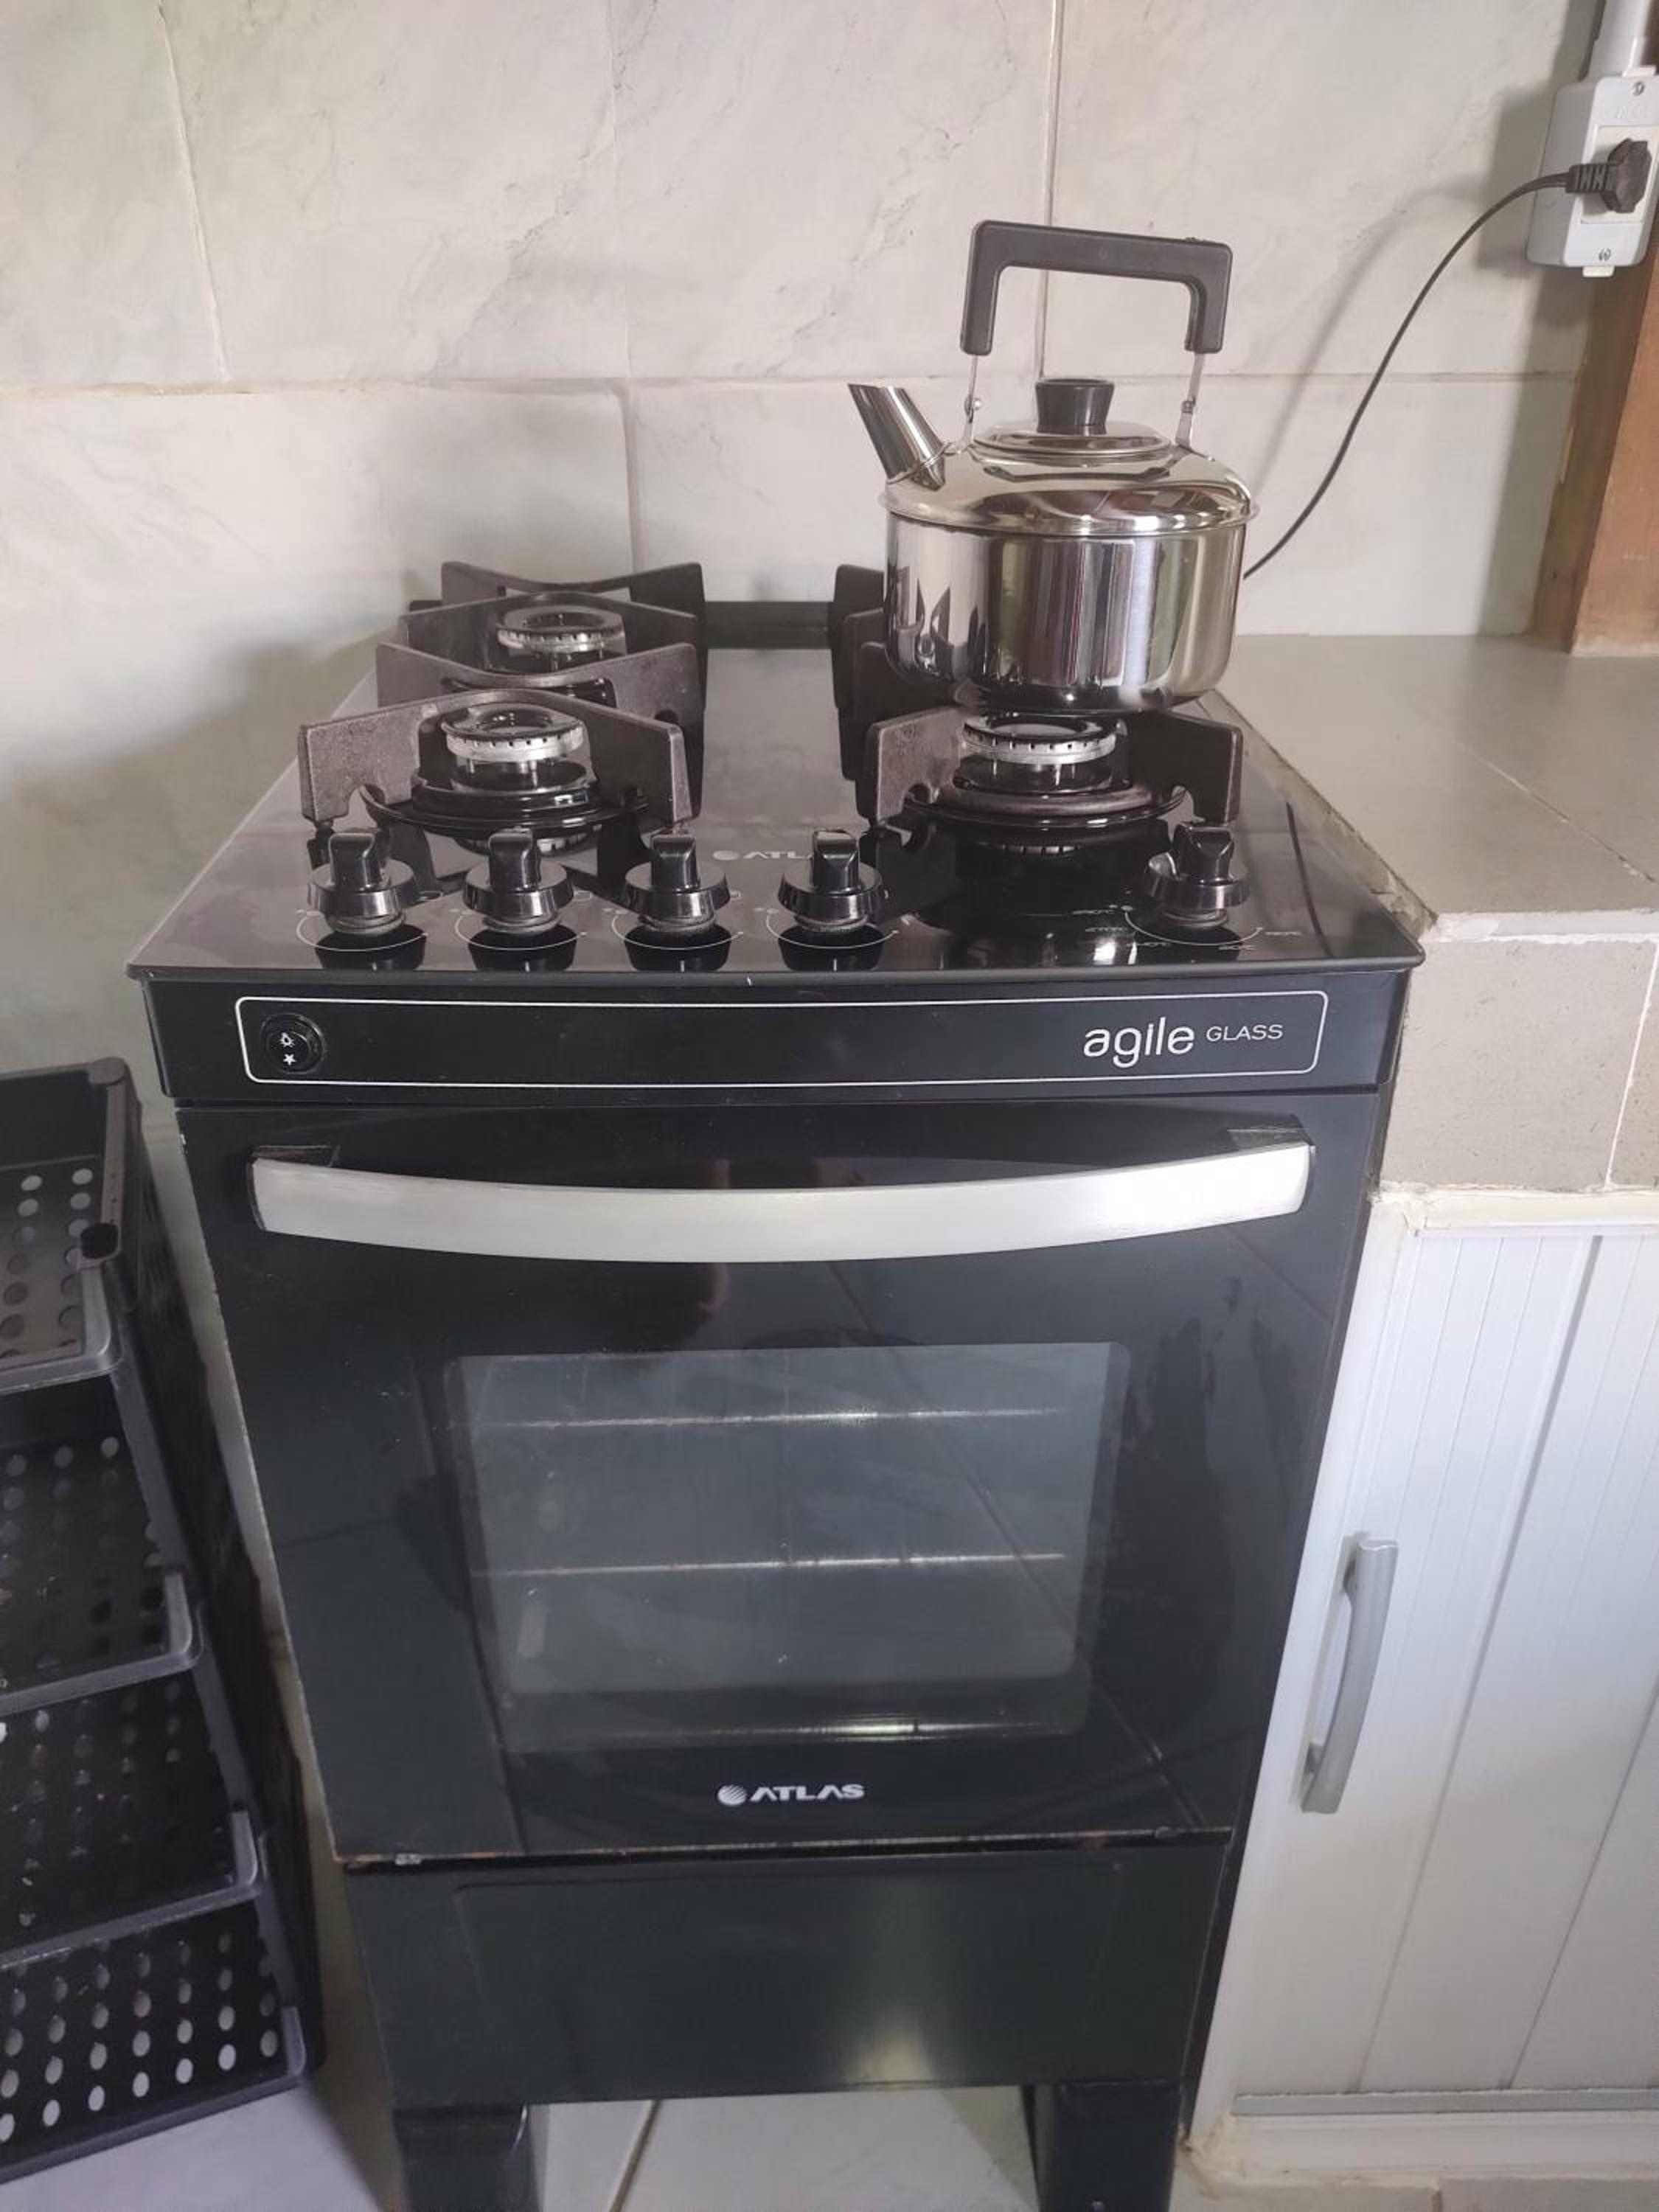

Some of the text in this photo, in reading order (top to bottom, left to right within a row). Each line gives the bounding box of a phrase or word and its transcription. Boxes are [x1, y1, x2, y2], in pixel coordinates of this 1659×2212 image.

[743, 851, 813, 859] ATL
[1083, 1017, 1284, 1068] agile GLASS
[750, 1784, 865, 1801] ATLAS
